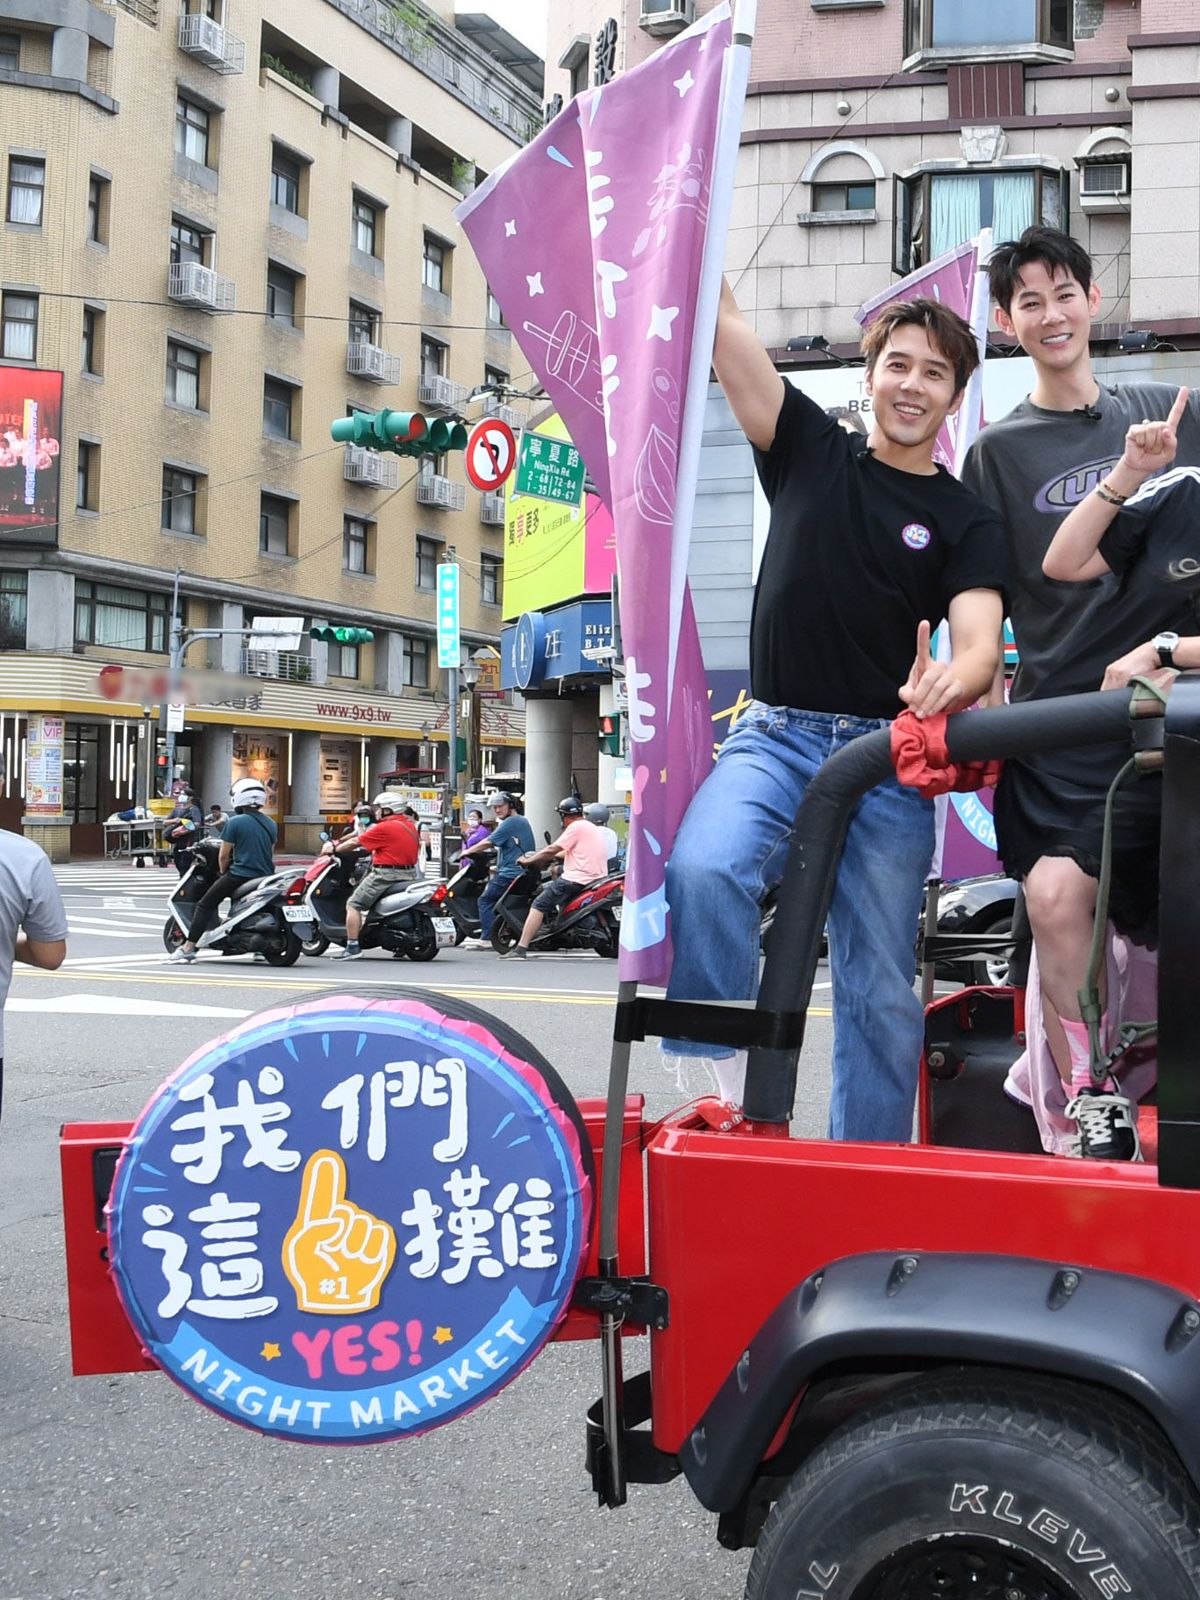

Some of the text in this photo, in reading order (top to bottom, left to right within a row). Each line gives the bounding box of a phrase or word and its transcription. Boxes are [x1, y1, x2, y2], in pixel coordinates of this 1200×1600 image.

[530, 438, 580, 468] 寧夏路
[585, 624, 612, 635] Eliz
[43, 727, 63, 738] VIP
[316, 701, 391, 722] www.9x9.tw
[170, 1057, 470, 1184] 我們
[142, 1165, 559, 1319] 這 攤
[318, 1275, 351, 1302] #1
[292, 1319, 424, 1380] YES!
[181, 1319, 527, 1430] NIGHT MARKET
[950, 1483, 1132, 1600] KLEVE
